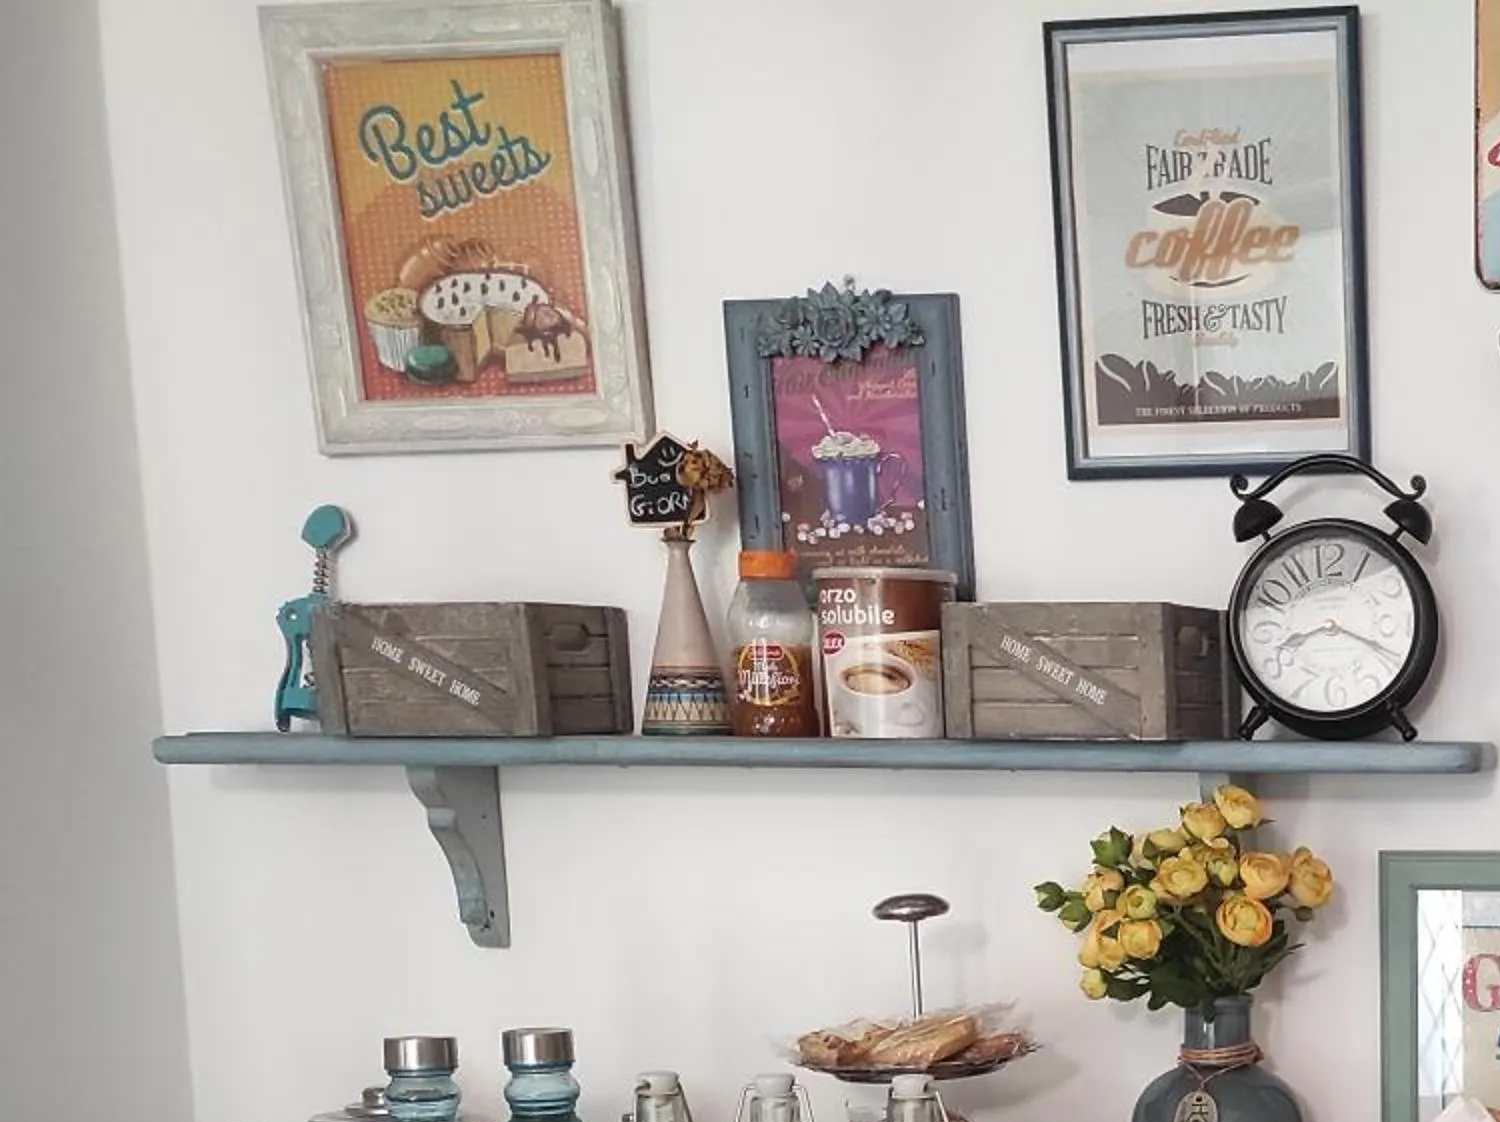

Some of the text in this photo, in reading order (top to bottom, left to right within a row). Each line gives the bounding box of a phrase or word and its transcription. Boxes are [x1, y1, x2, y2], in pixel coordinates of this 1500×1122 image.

[358, 79, 491, 180] Best
[415, 127, 550, 219] sweets
[1124, 199, 1300, 282] coffee
[1142, 299, 1200, 339] FRESH
[1229, 296, 1287, 334] TASTY
[1313, 543, 1345, 579] 12
[820, 588, 857, 603] orzo
[820, 604, 895, 625] solubile
[1256, 578, 1292, 615] 10
[370, 635, 481, 706] HOME SWEET HOME
[1000, 634, 1108, 705] HOME SWEET HOME
[1324, 676, 1347, 708] 6
